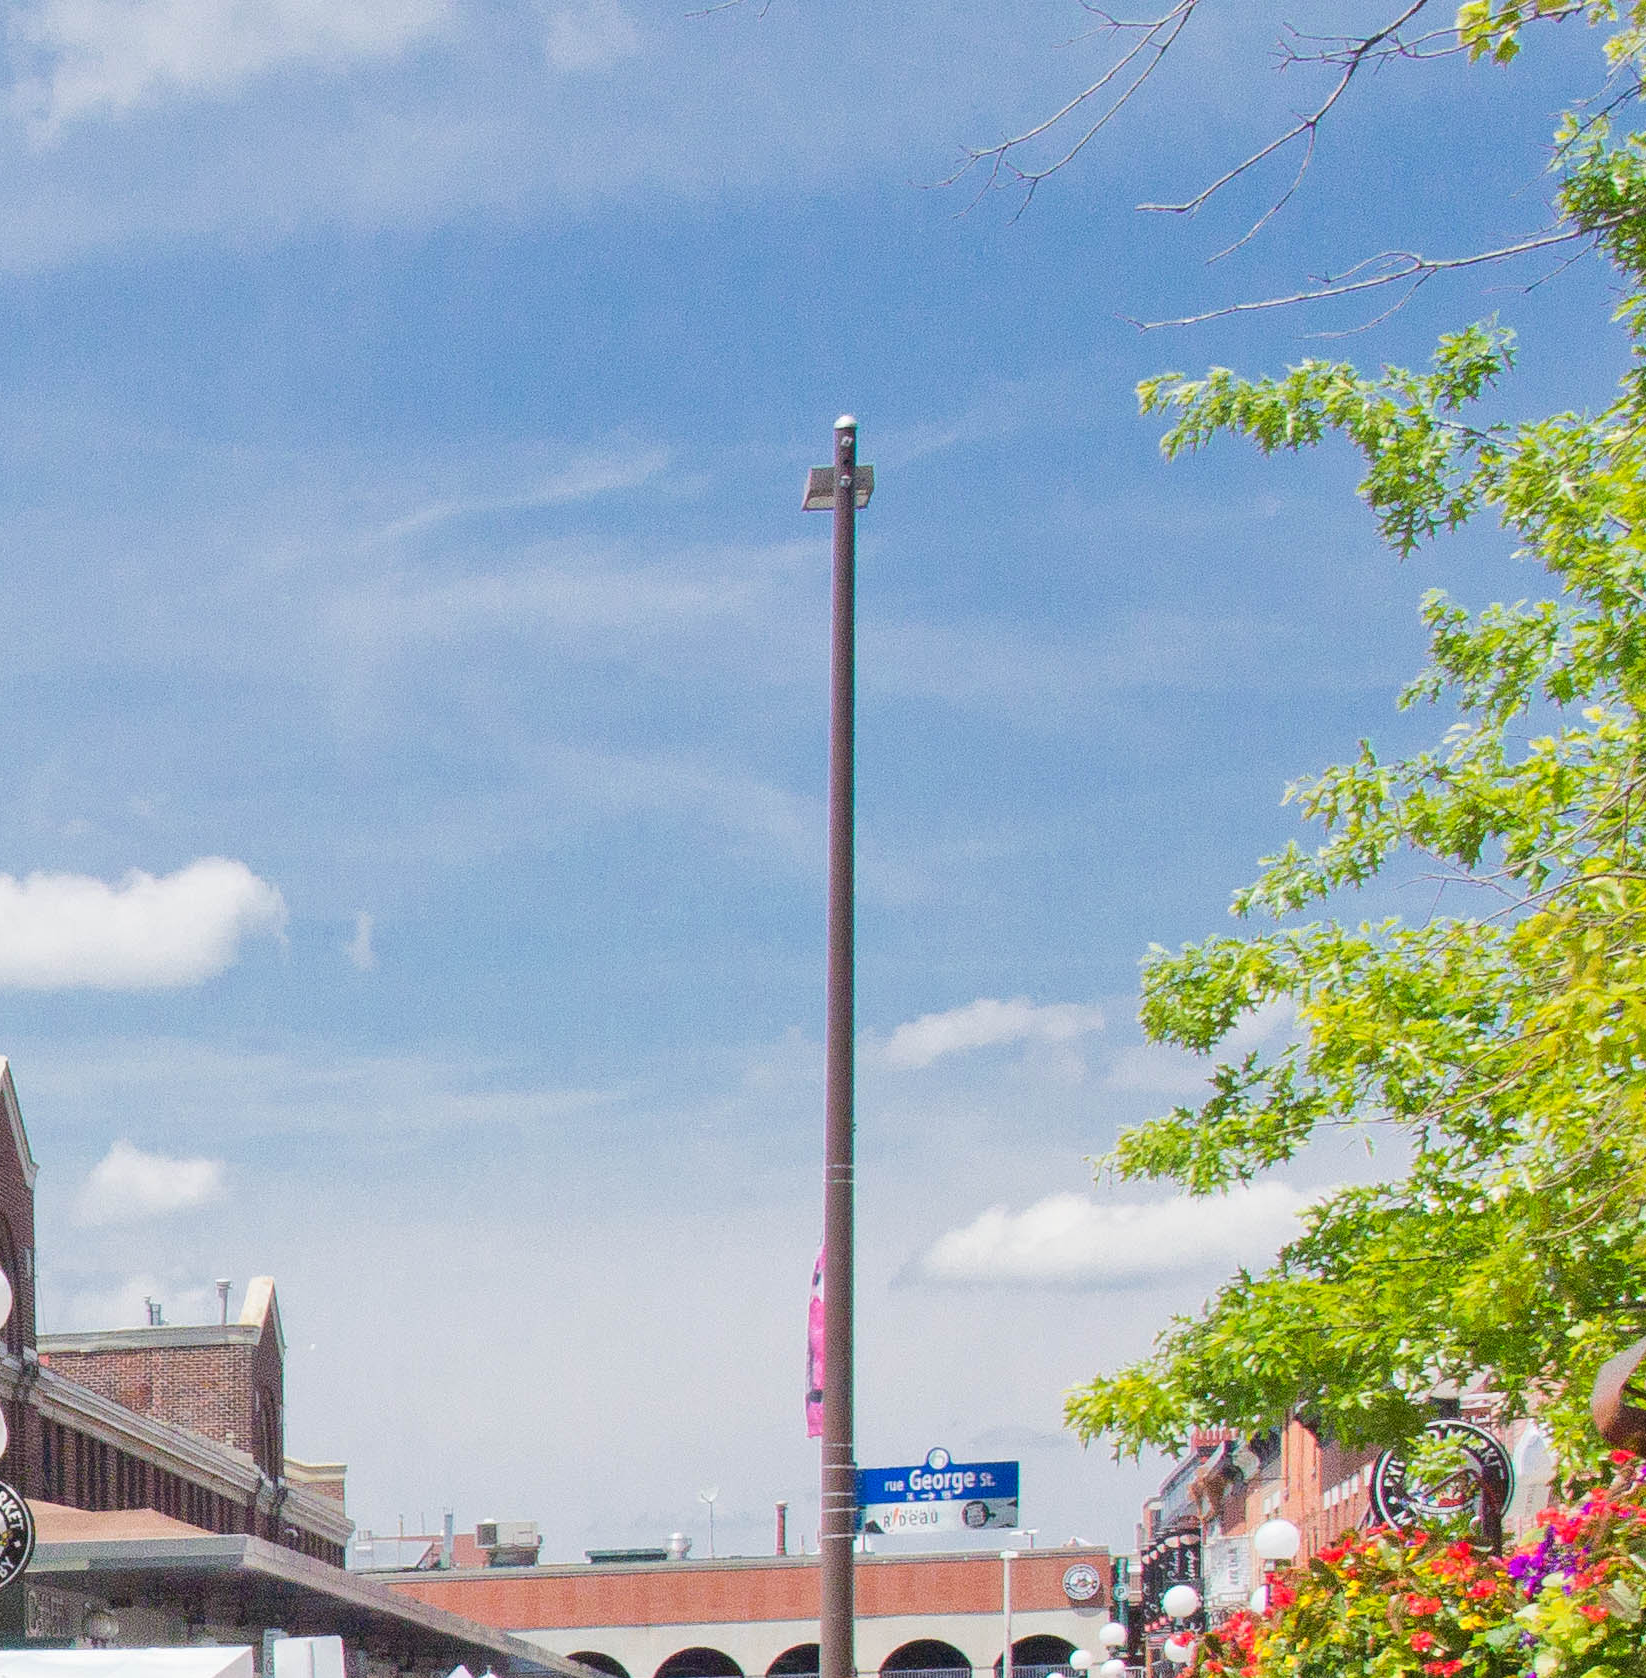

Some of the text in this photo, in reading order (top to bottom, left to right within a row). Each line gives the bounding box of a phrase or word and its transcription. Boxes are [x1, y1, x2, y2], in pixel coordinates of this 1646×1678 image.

[884, 1469, 997, 1494] rue George St.
